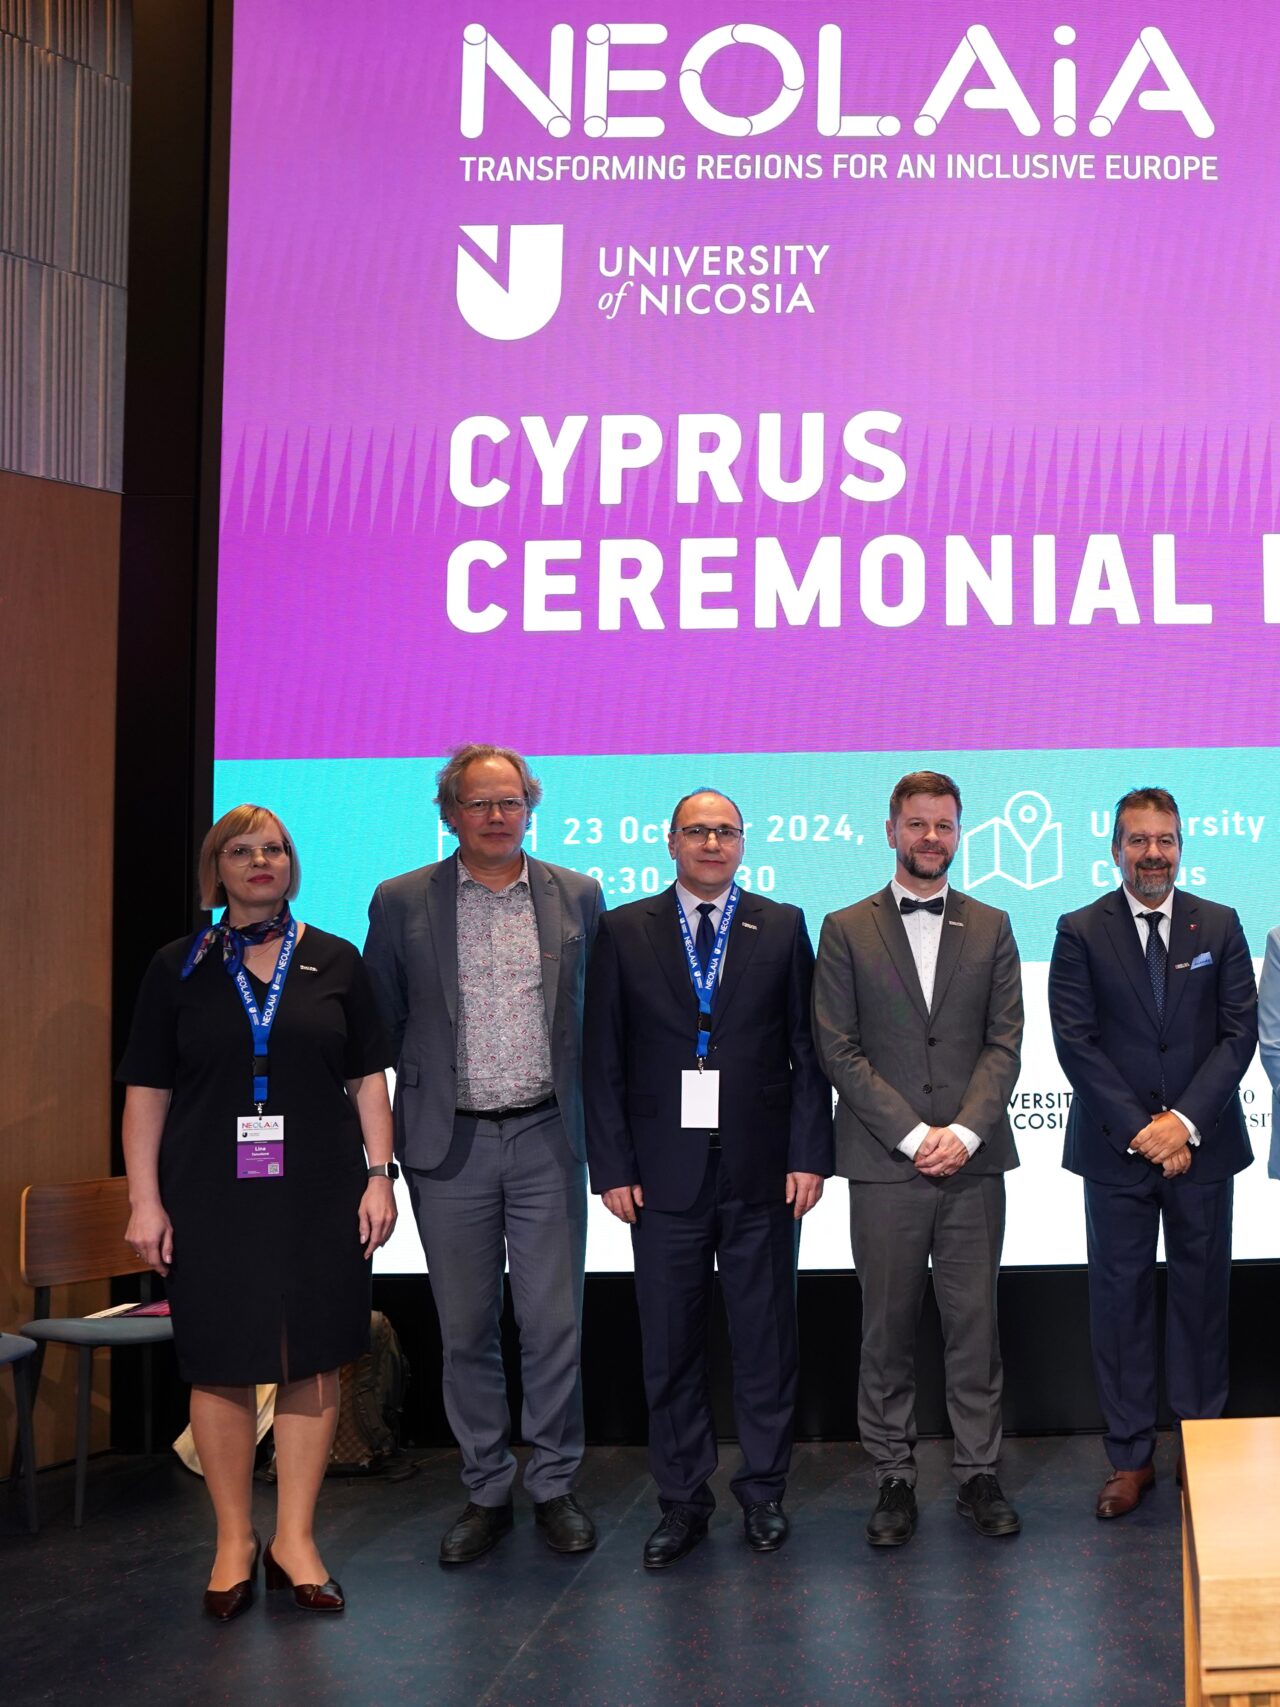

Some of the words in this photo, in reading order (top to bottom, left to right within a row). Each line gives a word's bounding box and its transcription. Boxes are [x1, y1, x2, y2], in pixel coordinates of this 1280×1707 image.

[460, 23, 1215, 139] NEOLAiA
[459, 154, 686, 182] TRANSFORMING
[696, 153, 823, 180] REGIONS
[833, 153, 888, 179] FOR
[896, 153, 936, 179] AN
[947, 153, 1096, 179] INCLUSIVE
[1105, 154, 1218, 181] EUROPE
[599, 244, 830, 278] UNIVERSITY
[598, 280, 634, 320] of
[640, 282, 815, 316] NICOSIA
[449, 410, 907, 508] CYPRUS
[446, 533, 1213, 634] CEREMONIAL
[563, 817, 603, 845] 23
[766, 814, 864, 845] 2024,
[1009, 1092, 1073, 1110] VERSIT
[1009, 1112, 1066, 1130] COSI
